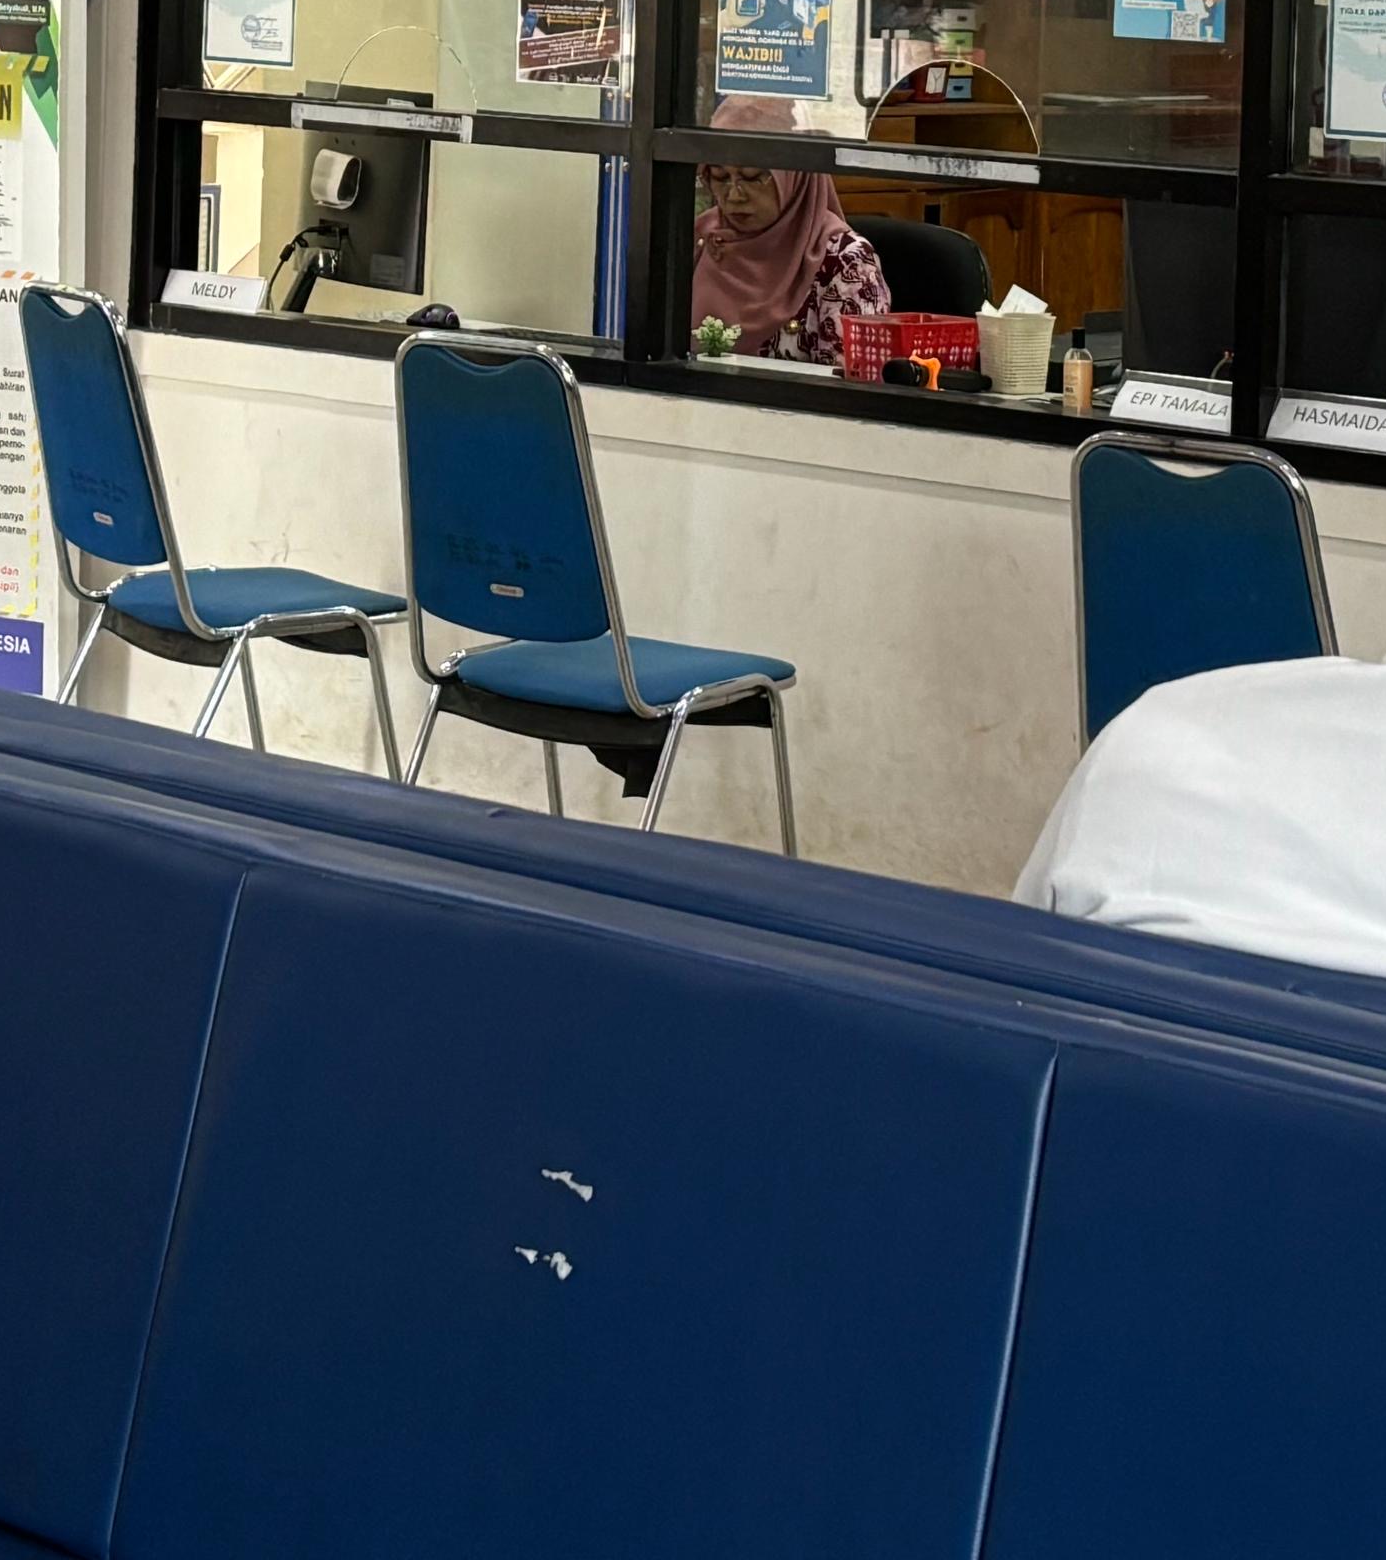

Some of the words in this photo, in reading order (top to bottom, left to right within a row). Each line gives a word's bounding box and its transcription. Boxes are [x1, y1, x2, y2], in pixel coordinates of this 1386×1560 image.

[191, 281, 236, 300] MELDY
[1130, 390, 1158, 409] EPI
[1161, 393, 1230, 418] TAMALA
